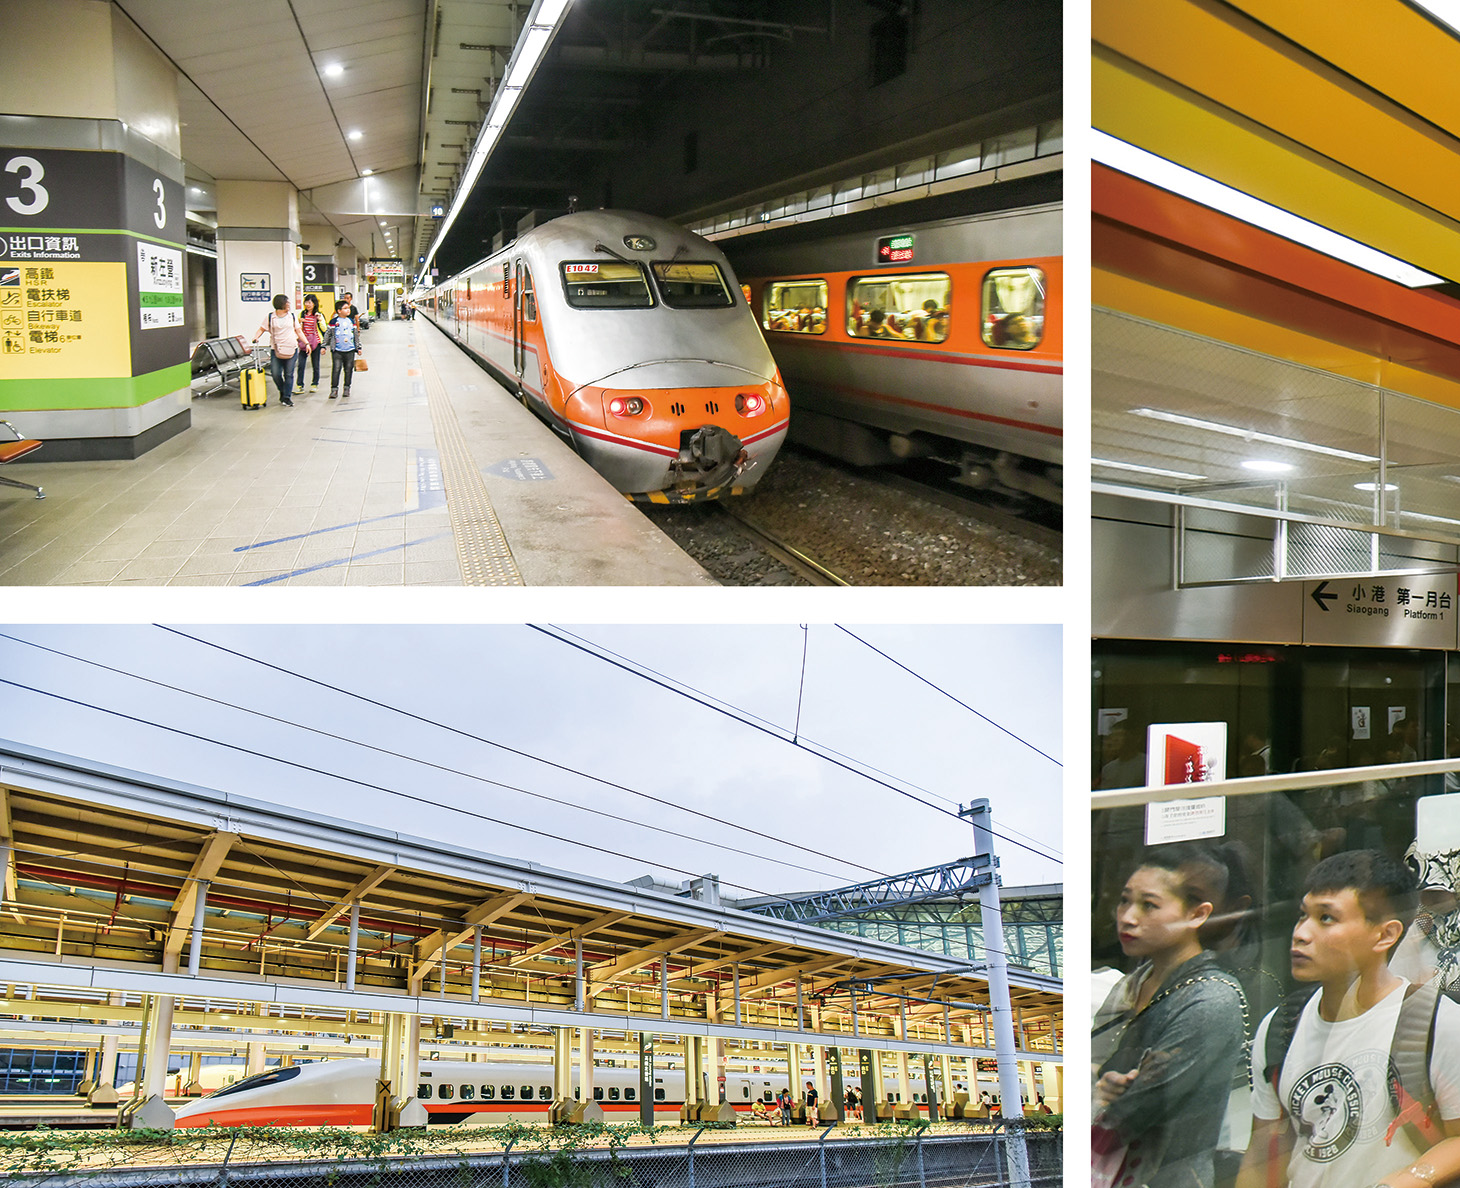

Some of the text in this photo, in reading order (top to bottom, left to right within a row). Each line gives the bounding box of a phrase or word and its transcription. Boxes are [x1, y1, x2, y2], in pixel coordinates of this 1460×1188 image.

[4, 156, 49, 215] 3
[153, 178, 166, 229] 3
[432, 207, 443, 215] 10
[10, 236, 79, 251] 出口資訊
[25, 267, 54, 280] 高鐵
[305, 265, 316, 281] 3
[566, 265, 598, 273] E1042
[26, 288, 70, 301] 電扶梯
[27, 309, 82, 322] 自行車道
[27, 323, 60, 331] Bikeway
[28, 330, 58, 343] 電梯
[29, 346, 62, 354] Elevator
[1352, 584, 1451, 609] 小港 第一月台
[1346, 603, 1444, 620] Siaogang Platform 1
[1318, 1144, 1340, 1158] 1928
